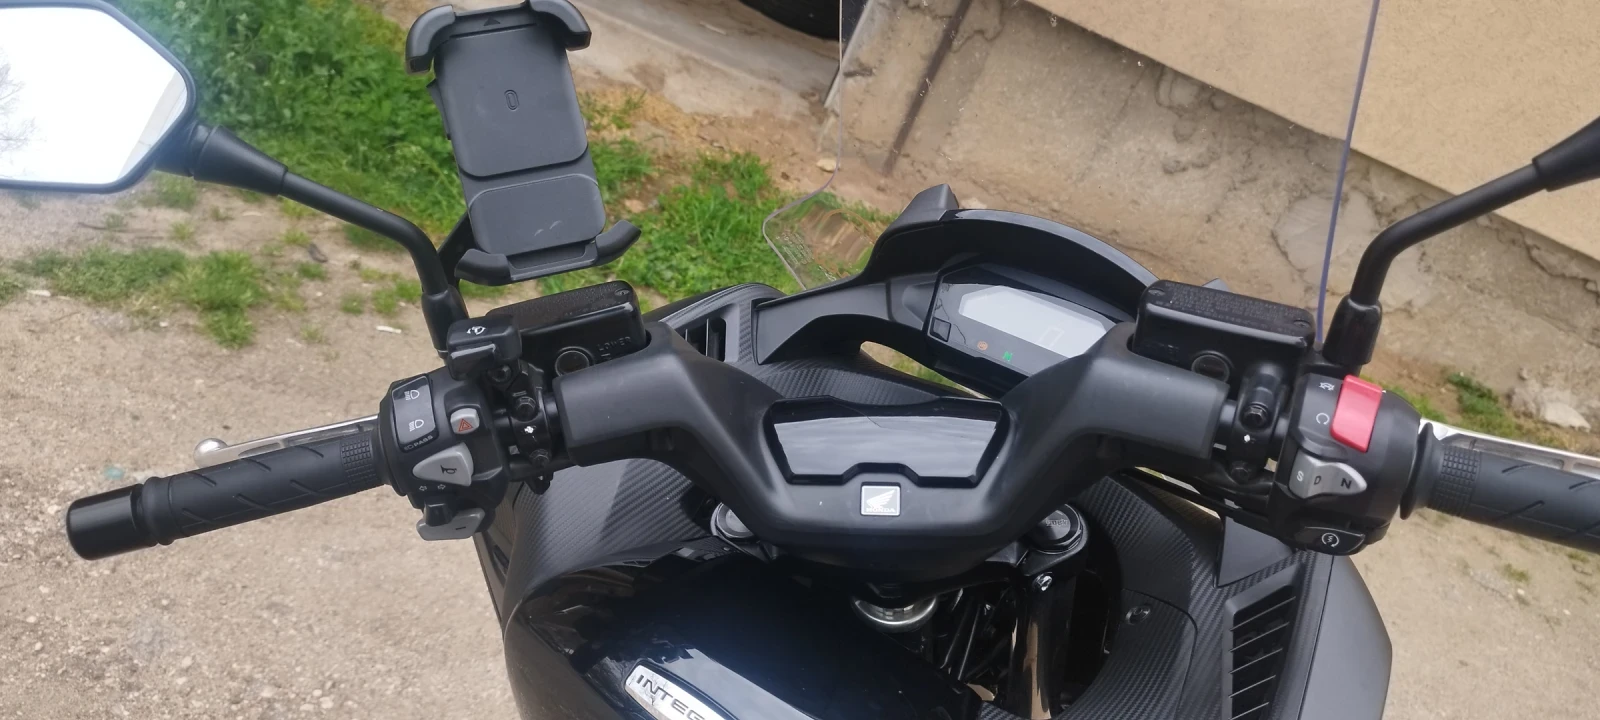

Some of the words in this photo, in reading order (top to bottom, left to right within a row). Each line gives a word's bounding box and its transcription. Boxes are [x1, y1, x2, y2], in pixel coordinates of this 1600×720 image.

[413, 435, 433, 447] PASS
[1296, 470, 1304, 482] S
[1313, 475, 1322, 486] D
[1341, 477, 1352, 490] N
